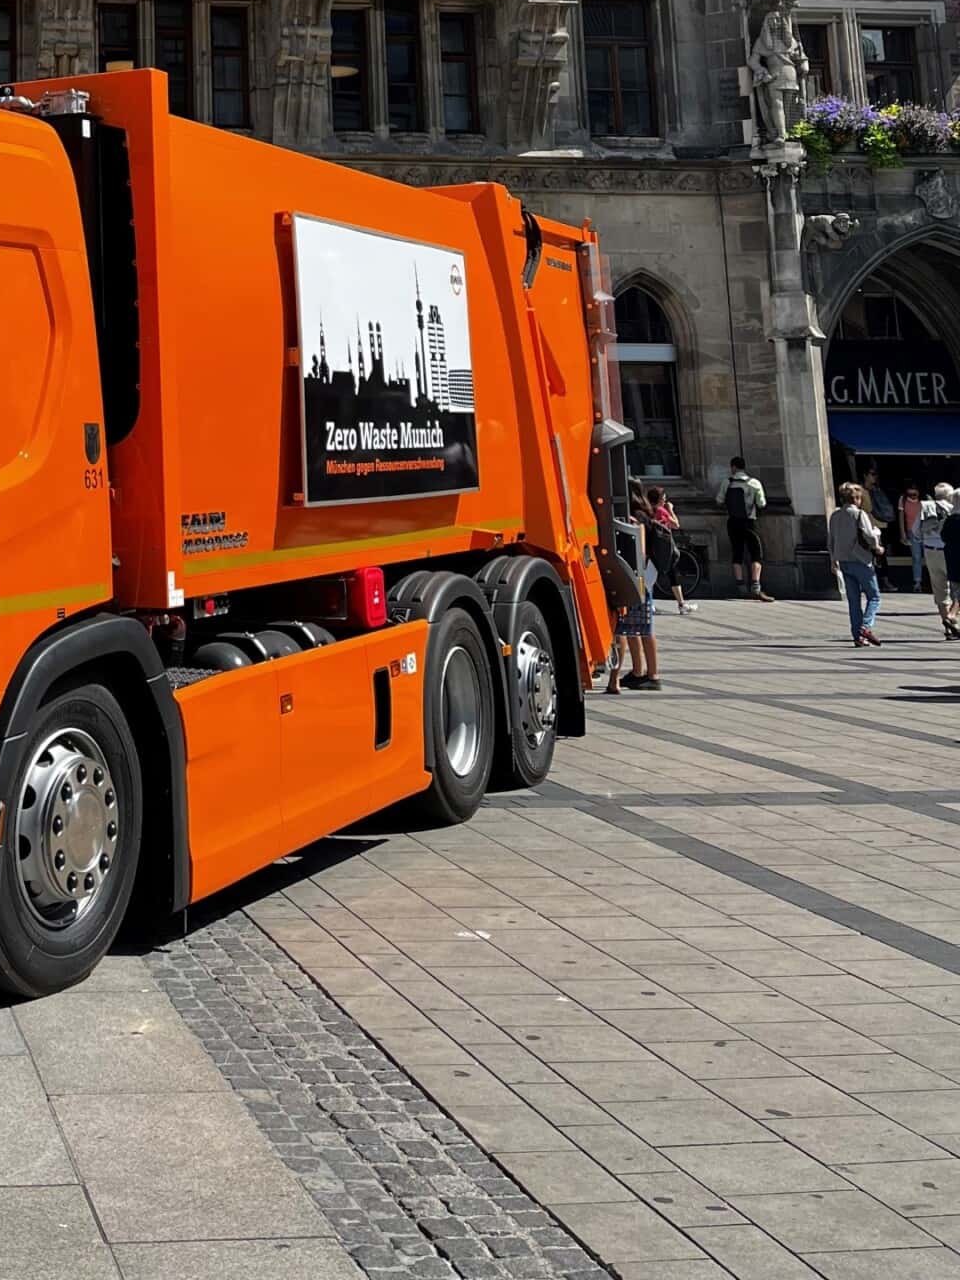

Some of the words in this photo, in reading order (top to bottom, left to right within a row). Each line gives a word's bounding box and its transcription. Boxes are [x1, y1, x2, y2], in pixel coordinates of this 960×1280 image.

[857, 365, 949, 405] MAYER
[325, 421, 358, 451] Zero
[359, 421, 398, 450] Waste
[400, 419, 444, 449] Munich
[84, 469, 104, 489] 631
